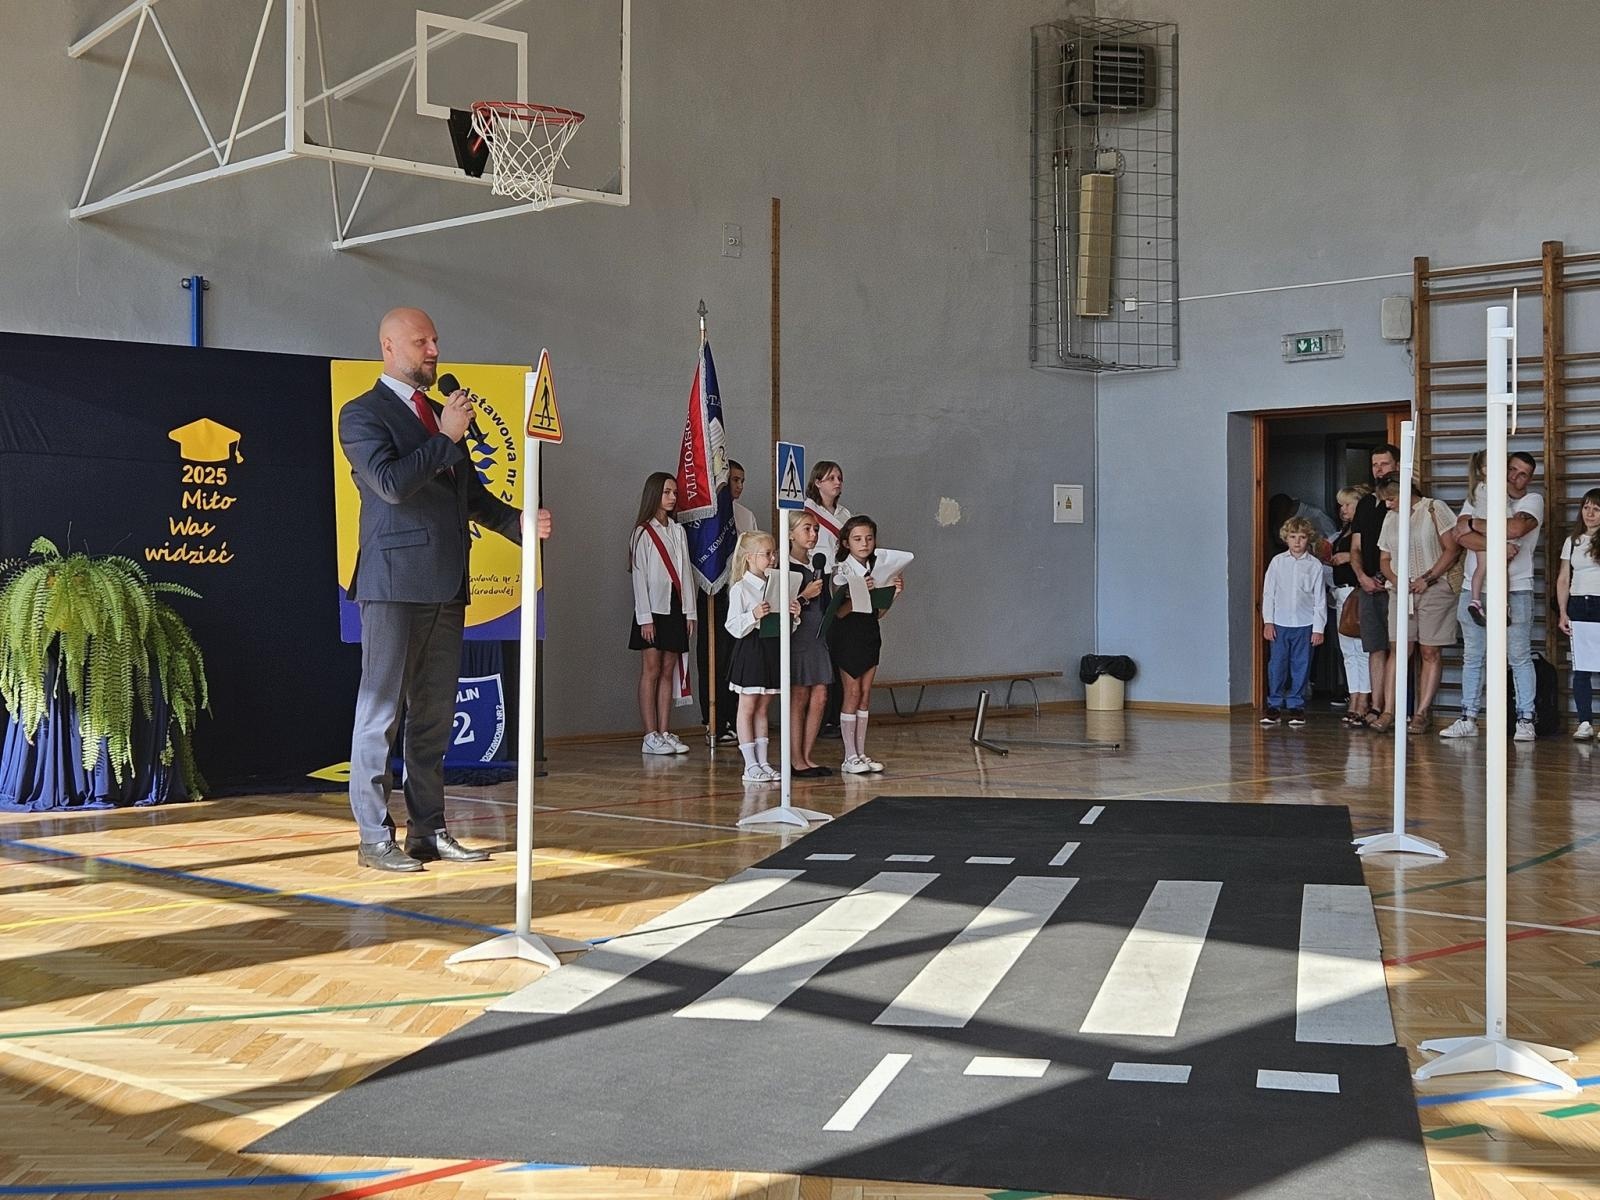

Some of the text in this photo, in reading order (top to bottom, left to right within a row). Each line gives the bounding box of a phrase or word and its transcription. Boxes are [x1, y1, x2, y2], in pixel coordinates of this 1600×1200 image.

[461, 388, 517, 502] dstawowa nr 2
[684, 410, 698, 501] OSPOLITA
[182, 465, 227, 485] 2025
[182, 489, 237, 510] Miło
[169, 516, 216, 537] Was
[145, 542, 234, 564] widzieć
[469, 574, 499, 583] awowa
[502, 575, 512, 584] nr
[456, 687, 480, 704] LIN
[453, 711, 475, 745] 2
